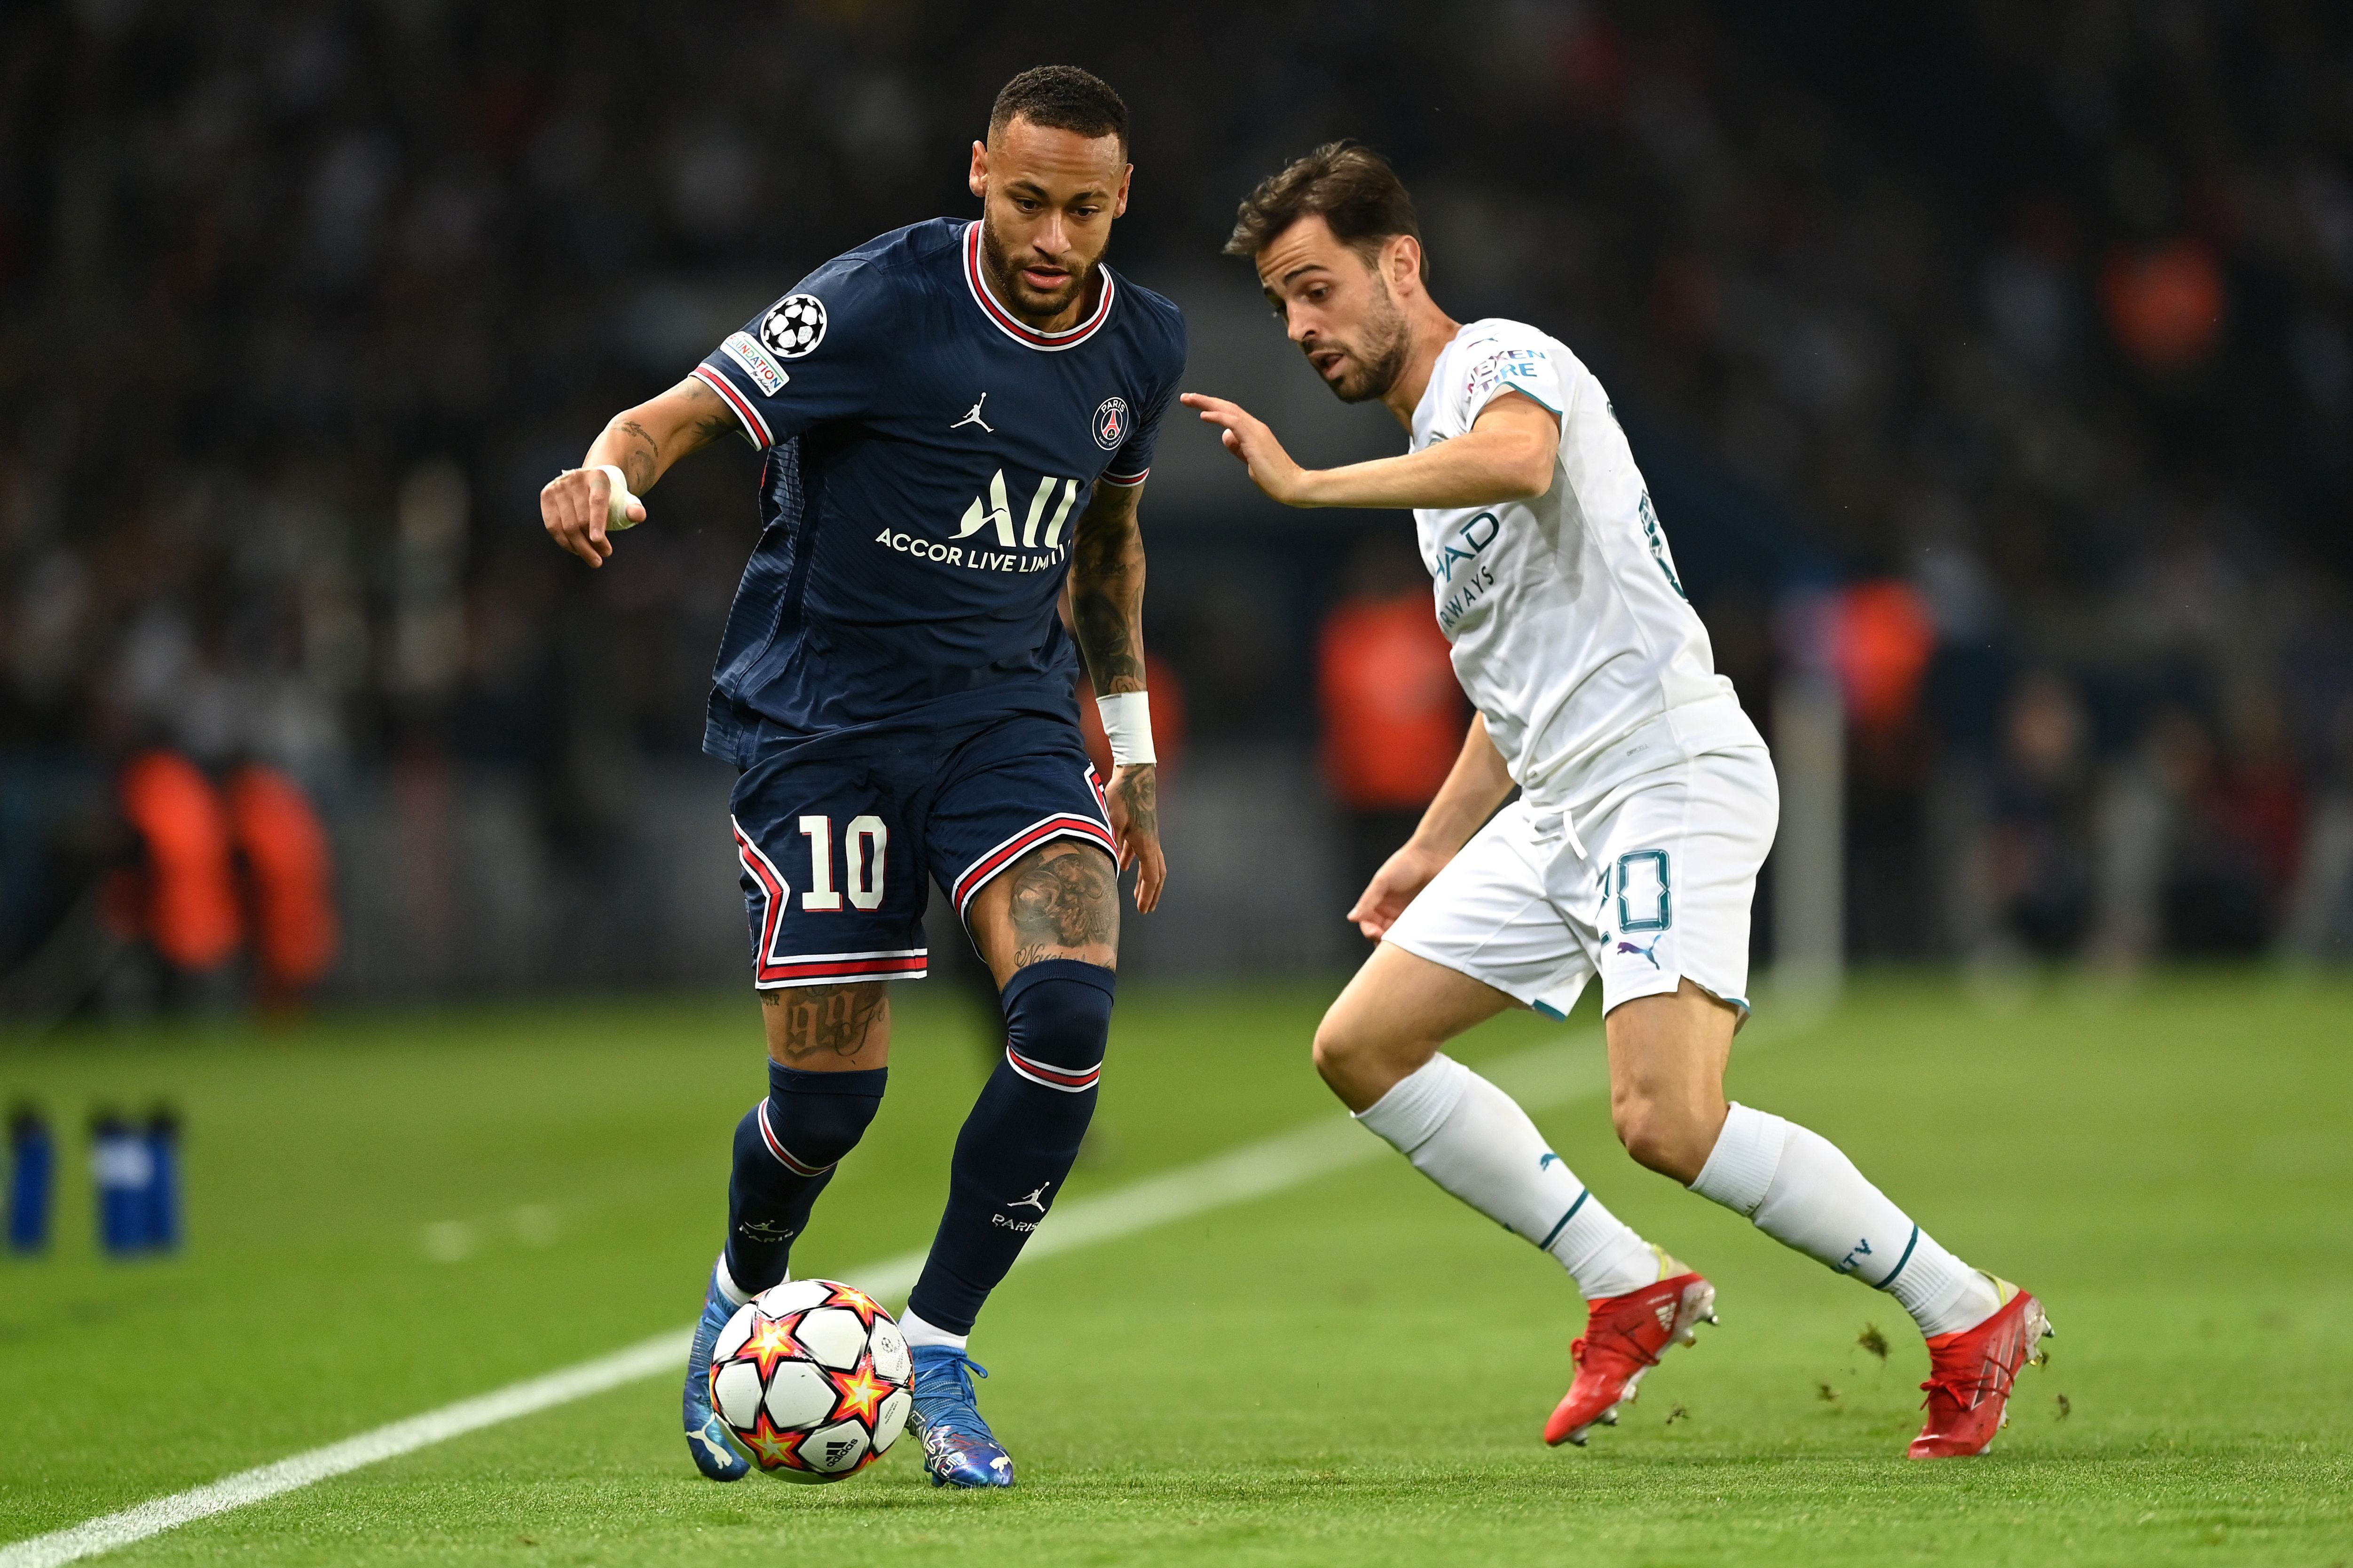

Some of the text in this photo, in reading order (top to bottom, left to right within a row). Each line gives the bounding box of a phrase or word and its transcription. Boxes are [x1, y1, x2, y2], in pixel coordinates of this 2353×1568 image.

[757, 377, 771, 393] children
[1477, 362, 1537, 393] TIRE
[1101, 400, 1125, 414] PARIS
[875, 527, 962, 566] ACCOR
[967, 549, 1014, 572] LIVE
[799, 815, 889, 912] 10
[992, 1213, 1040, 1232] PARIS
[826, 1438, 858, 1467] adidas
